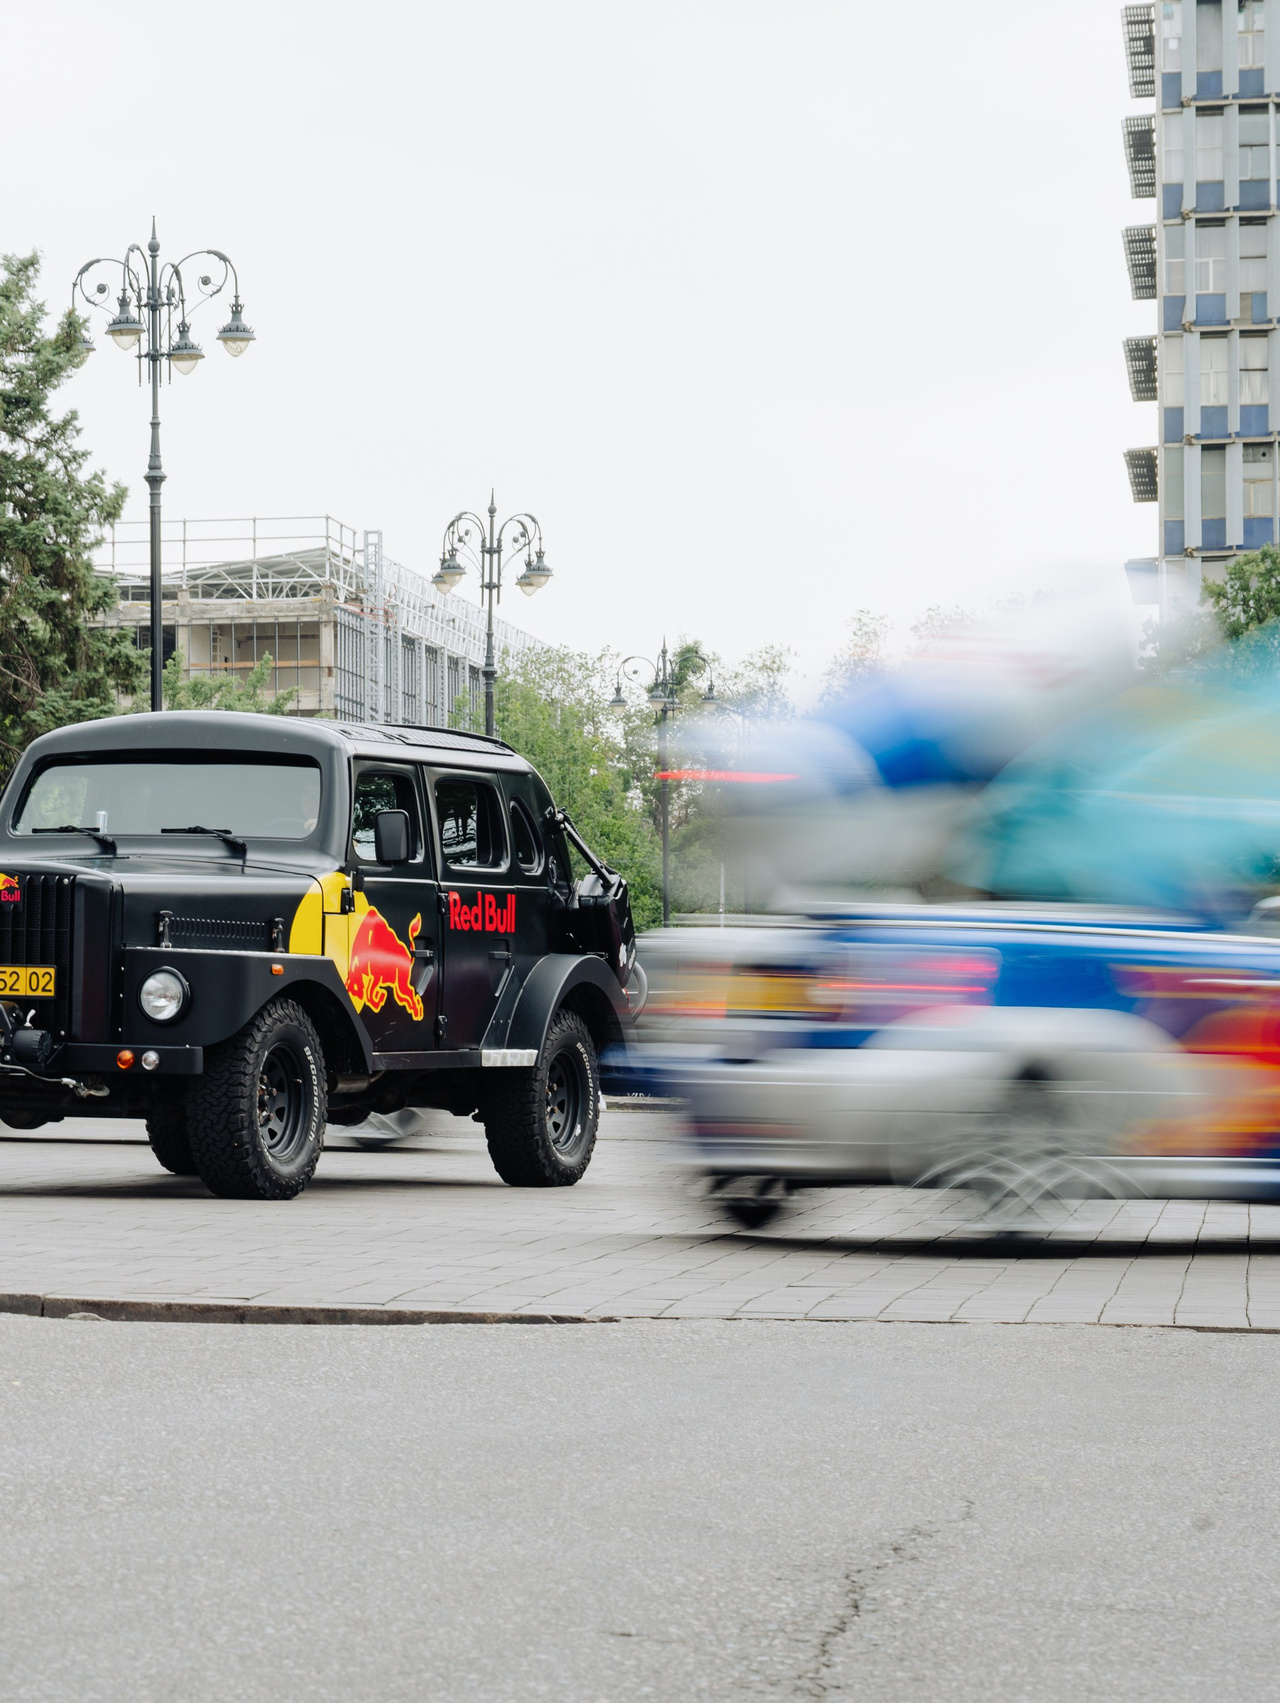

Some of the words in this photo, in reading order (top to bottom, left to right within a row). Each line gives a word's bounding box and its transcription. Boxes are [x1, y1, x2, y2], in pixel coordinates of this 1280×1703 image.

[1, 889, 21, 902] Bull
[448, 890, 482, 931] Red
[484, 893, 516, 934] Bull
[28, 971, 53, 993] 02
[303, 1045, 320, 1142] BFGoodrich
[576, 1041, 595, 1120] BFGoodrich
